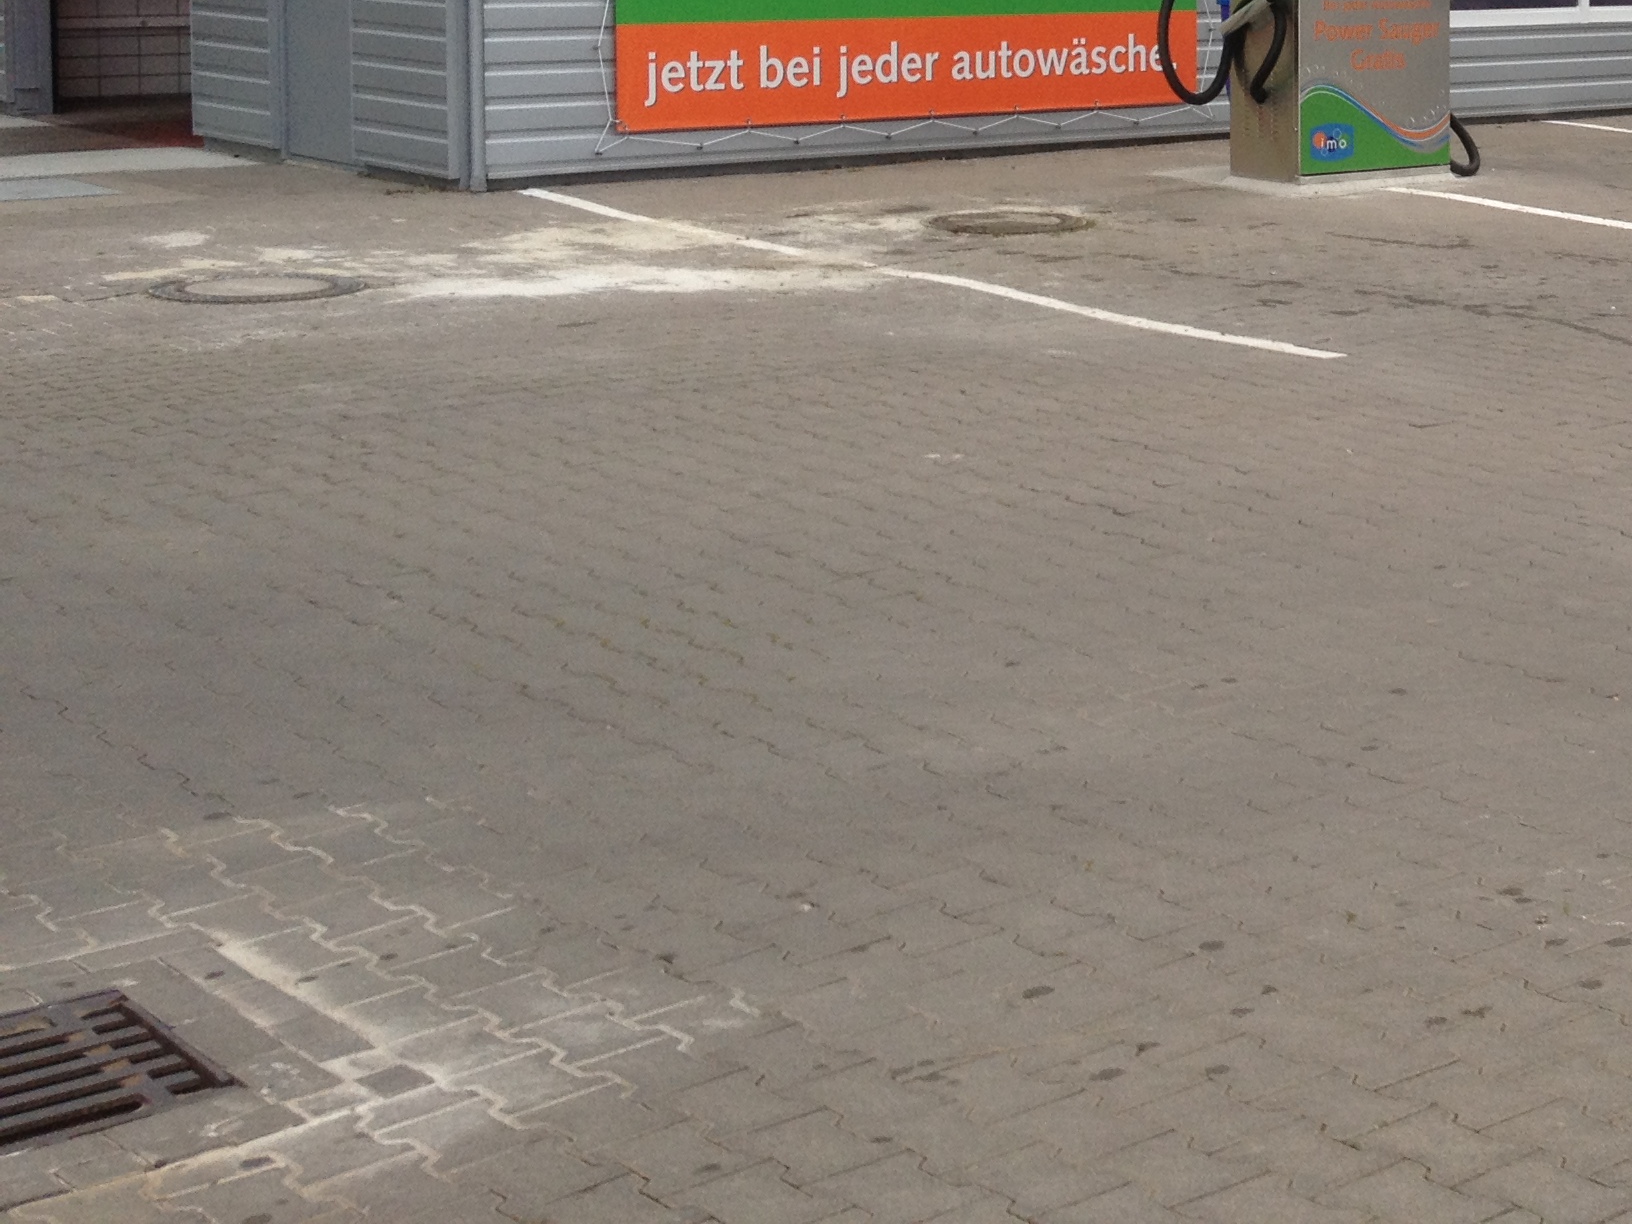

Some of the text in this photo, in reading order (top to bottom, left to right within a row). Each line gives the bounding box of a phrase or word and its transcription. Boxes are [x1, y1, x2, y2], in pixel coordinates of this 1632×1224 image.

[1313, 17, 1440, 46] Power Sauger
[1350, 48, 1407, 71] Gratis
[644, 51, 744, 107] jetzt
[759, 44, 822, 89] bei
[836, 40, 939, 98] jeder
[1320, 137, 1347, 150] imo
